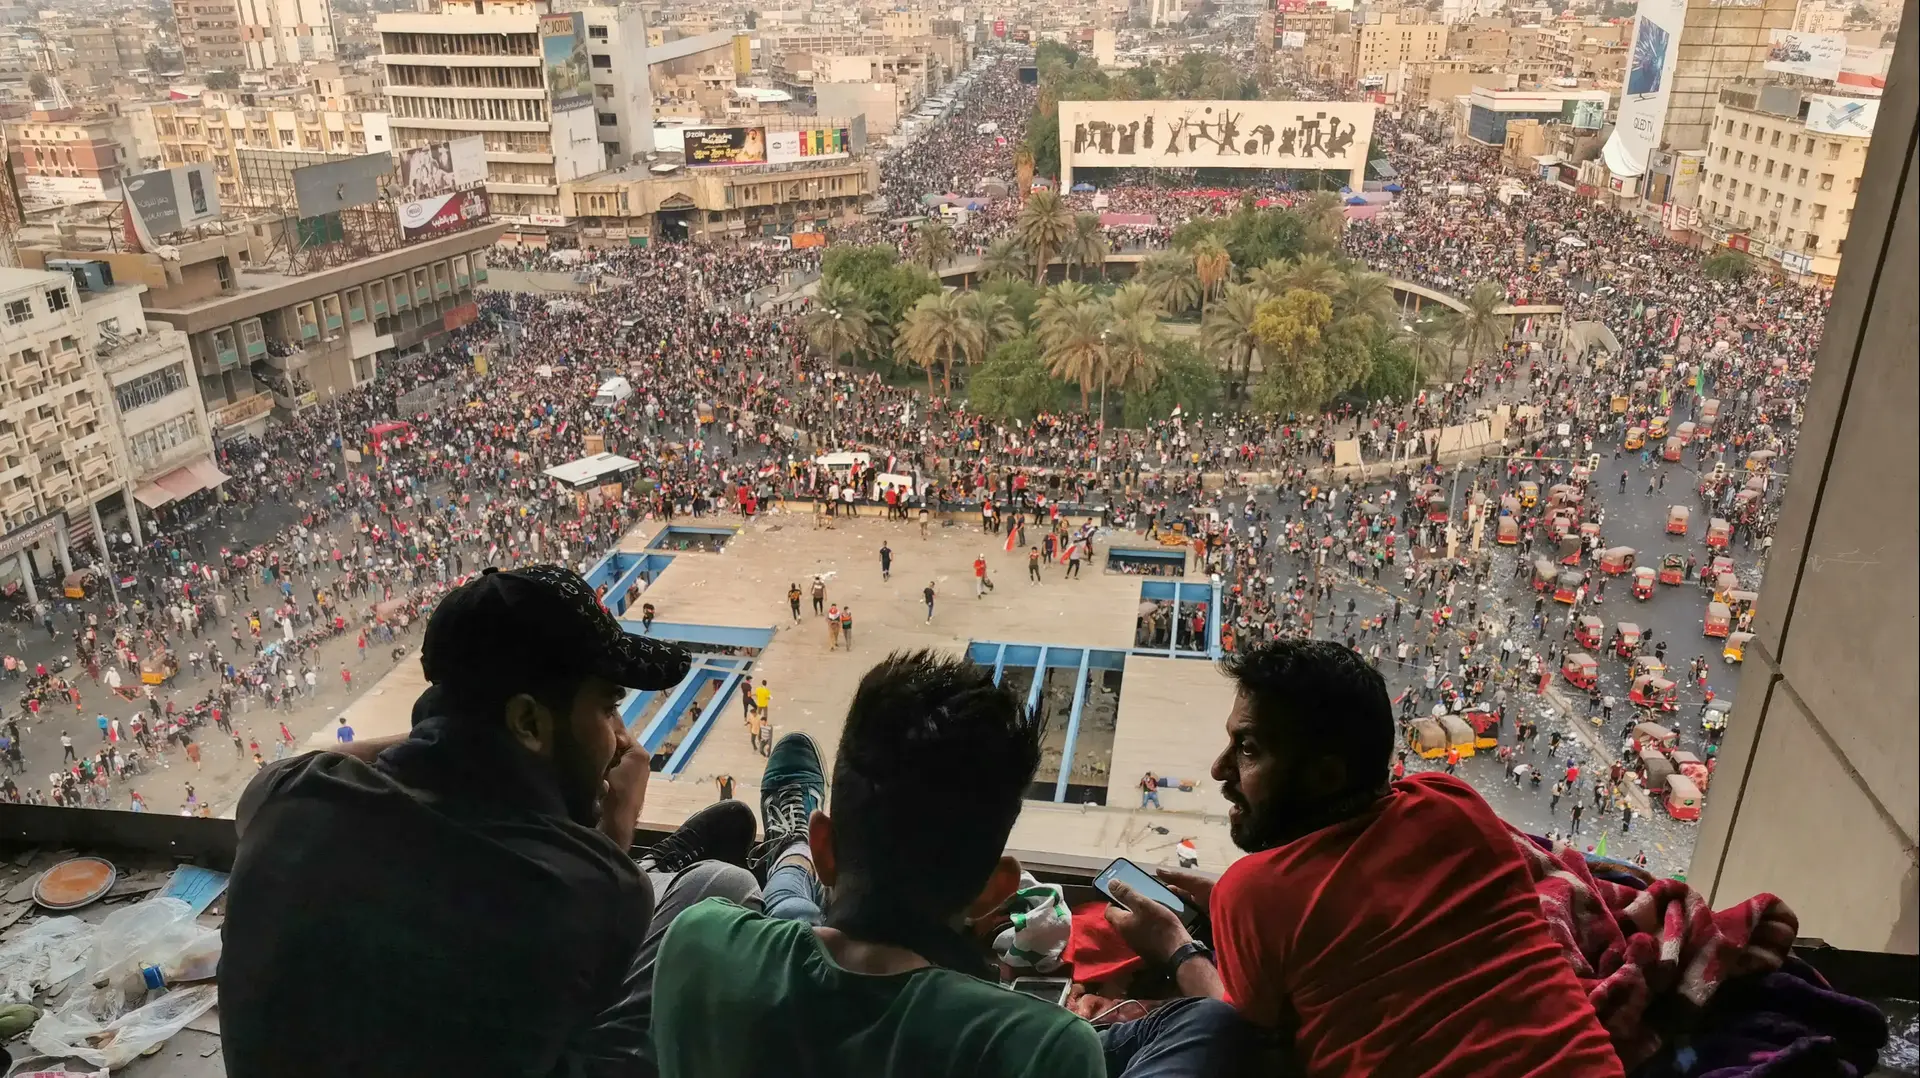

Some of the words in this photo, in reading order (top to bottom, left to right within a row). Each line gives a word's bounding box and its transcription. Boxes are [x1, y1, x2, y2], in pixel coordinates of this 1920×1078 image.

[551, 20, 573, 34] JOTUN
[1633, 117, 1647, 131] QLED
[1647, 120, 1655, 133] TV
